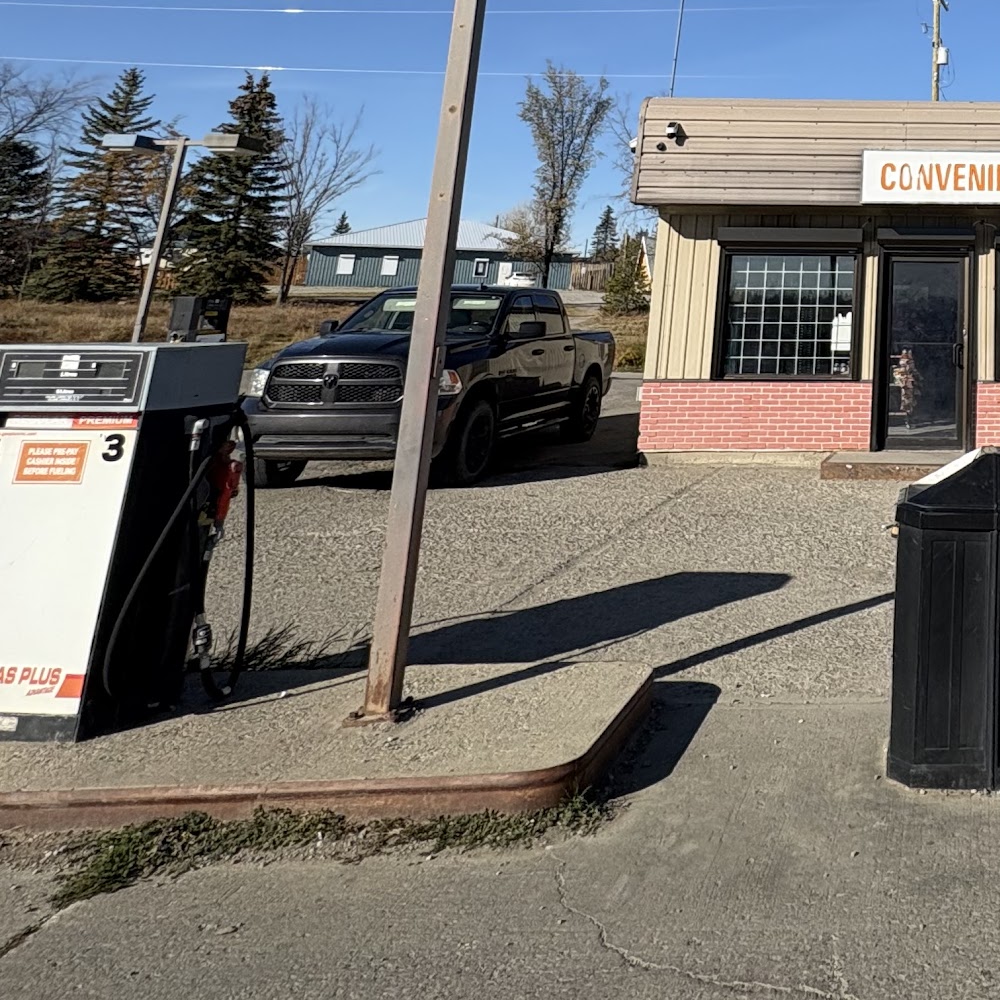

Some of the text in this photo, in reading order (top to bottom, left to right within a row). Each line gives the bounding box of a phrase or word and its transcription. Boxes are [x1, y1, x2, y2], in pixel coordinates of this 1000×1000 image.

[78, 416, 133, 425] PREMIUM
[28, 447, 52, 456] PLEASE
[101, 433, 126, 462] 3
[26, 457, 54, 466] CASHIER
[22, 467, 77, 475] BEFORE FUELING
[18, 667, 62, 685] PLUS
